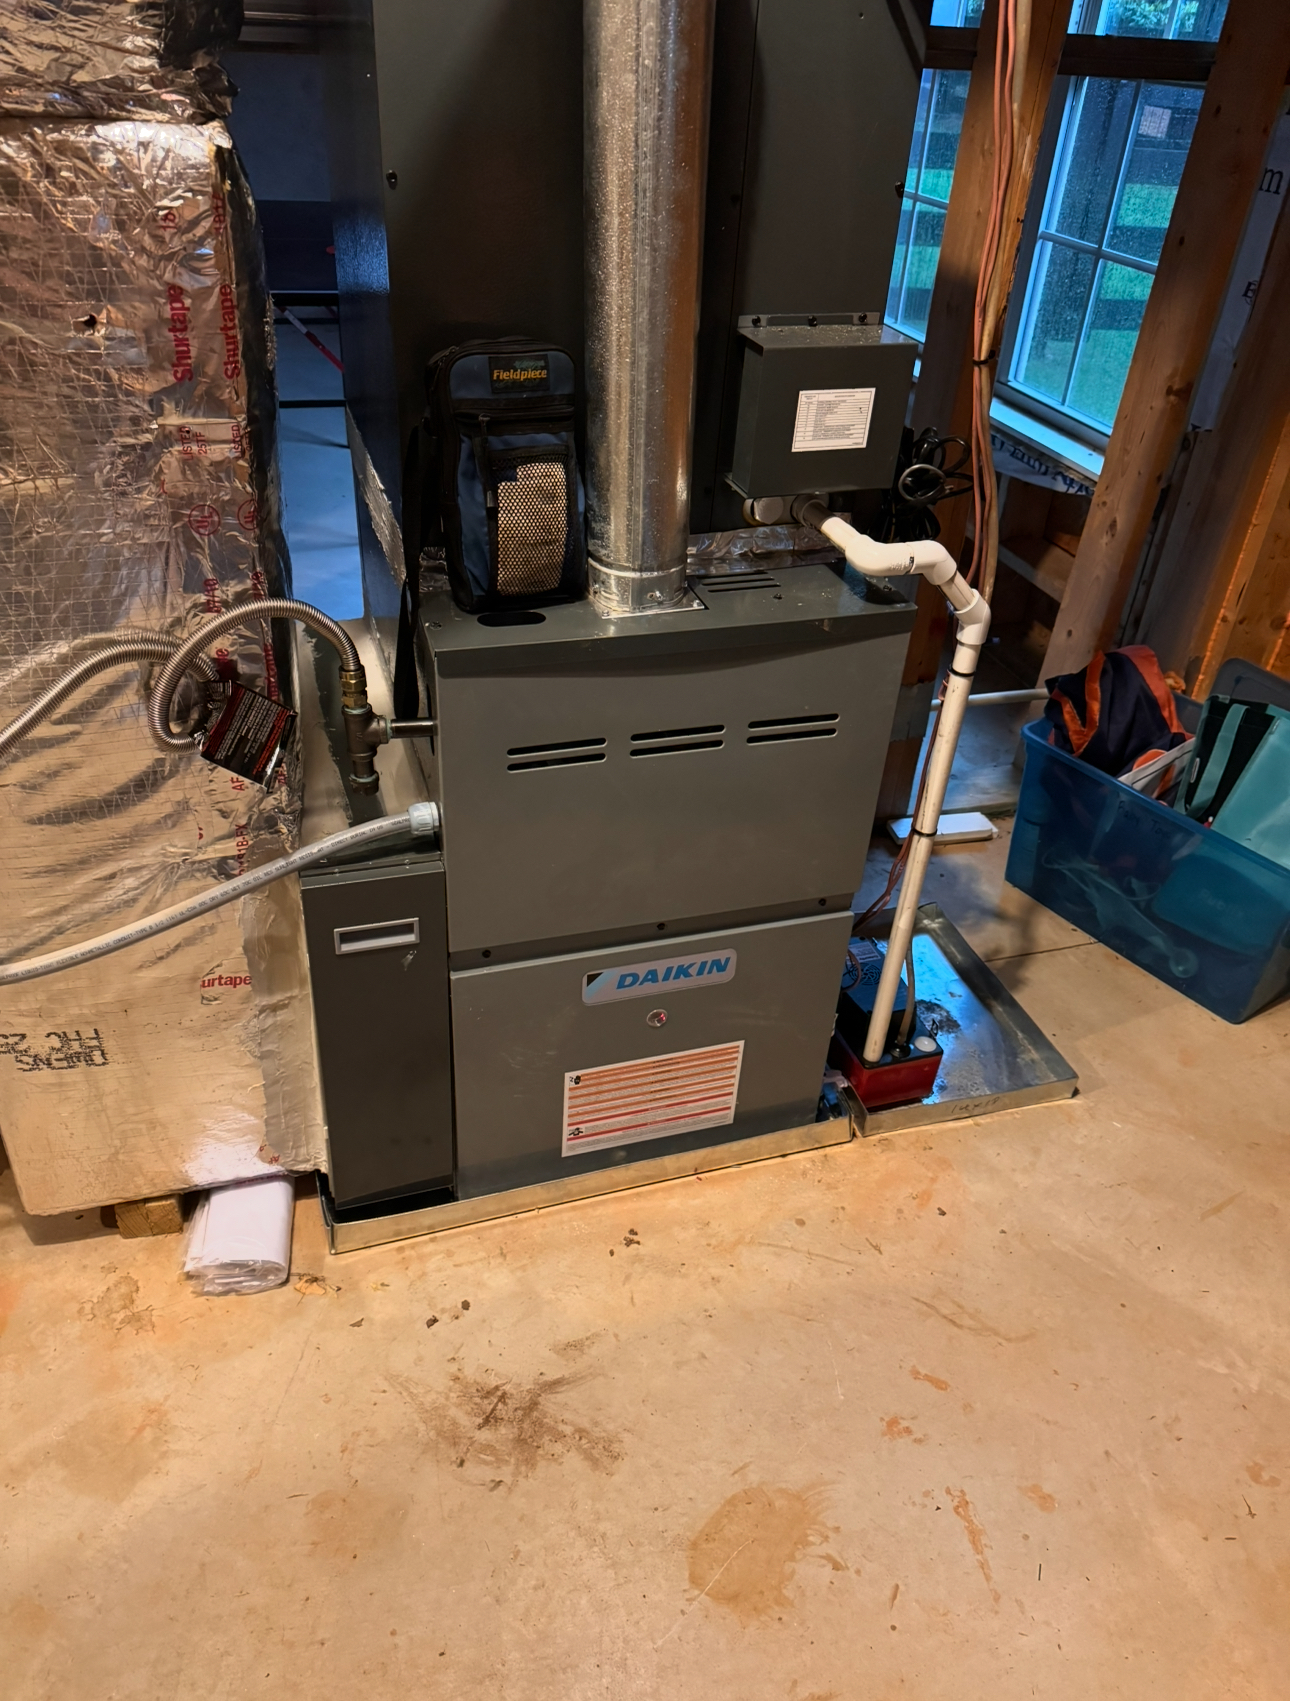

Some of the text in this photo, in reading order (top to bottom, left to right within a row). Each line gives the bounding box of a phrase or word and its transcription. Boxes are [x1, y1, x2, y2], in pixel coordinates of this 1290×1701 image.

[166, 284, 194, 384] Shurtape
[218, 284, 242, 380] Shurtape
[493, 368, 548, 381] Fieldpiece
[179, 426, 194, 461] LISTED
[195, 431, 208, 455] 25TF
[231, 425, 245, 460] LISTED
[113, 927, 148, 945] CONDUIT-TYPE
[230, 884, 242, 893] WET
[299, 846, 324, 861] RESISNT
[330, 837, 348, 848] DIRECT
[201, 974, 253, 989] urtape
[616, 956, 732, 990] DAIKIN
